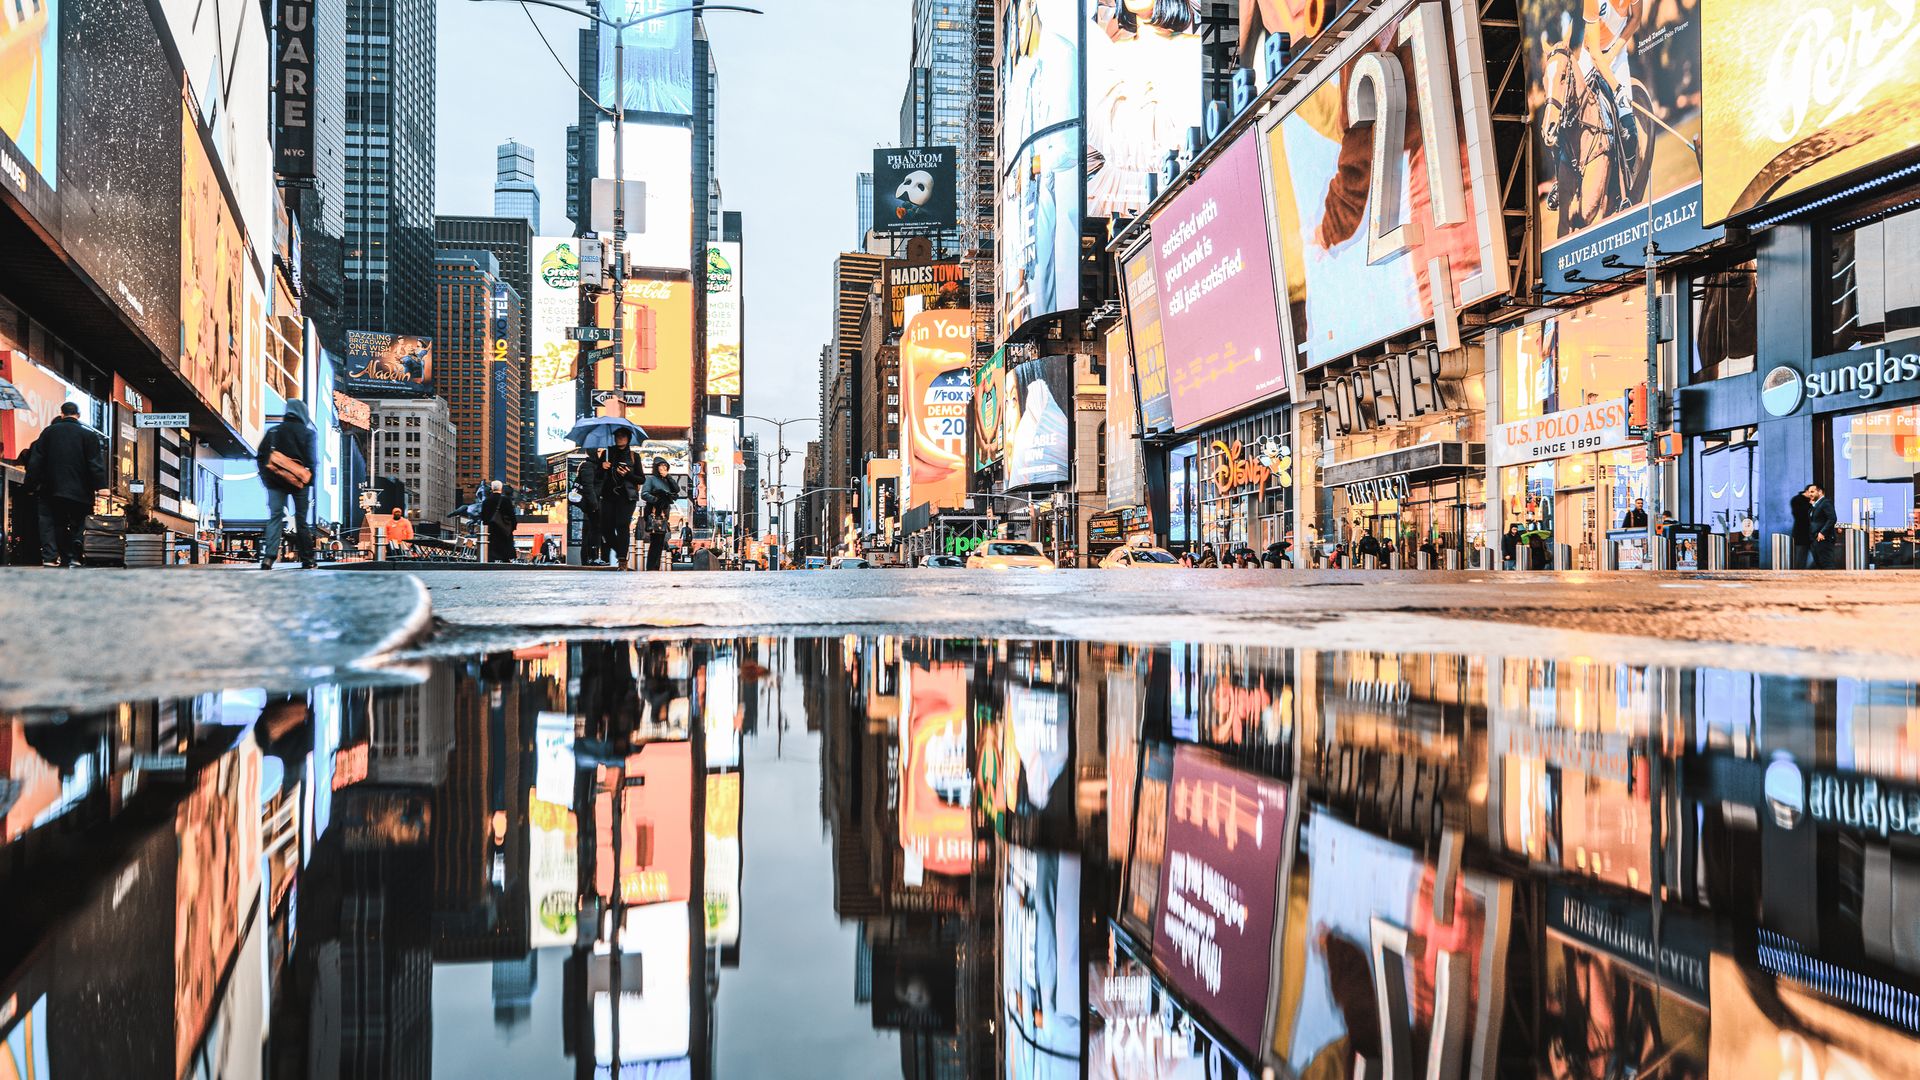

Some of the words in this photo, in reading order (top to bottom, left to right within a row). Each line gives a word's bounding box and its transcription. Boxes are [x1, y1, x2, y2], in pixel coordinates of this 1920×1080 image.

[1638, 36, 1664, 55] Professional
[1664, 31, 1674, 39] Polo
[1674, 21, 1689, 33] Player
[1638, 35, 1652, 48] Jared
[281, 0, 310, 127] UARE
[1347, 1, 1467, 266] 21
[284, 149, 305, 157] NYC
[887, 153, 942, 164] PHANTOM
[1162, 213, 1196, 258] satisfied
[1195, 198, 1217, 232] with
[1165, 263, 1183, 292] your
[1182, 242, 1203, 274] bank
[1201, 235, 1213, 257] is
[891, 264, 963, 286] HADESTOWN
[707, 283, 733, 292] iant
[891, 285, 909, 298] BEST
[909, 283, 941, 296] MUSICAL
[1169, 291, 1184, 316] still
[1183, 278, 1202, 313] just
[543, 306, 578, 315] VEGGIE
[348, 332, 391, 341] DAZZLING
[495, 291, 508, 361] NOVOTEL
[576, 329, 585, 339] W
[588, 330, 600, 340] 45
[917, 322, 929, 341] in
[934, 320, 972, 339] You
[348, 338, 391, 346] BROADWAY
[588, 350, 601, 359] George
[349, 360, 411, 381] Aladdin
[1805, 348, 1920, 399] sunglas
[942, 391, 964, 401] FOX
[1320, 343, 1450, 440] FOREVER
[1506, 424, 1533, 447] U.S.
[1536, 414, 1580, 441] POLO
[1867, 414, 1891, 426] GIFT
[1533, 443, 1566, 456] SINCE
[1572, 436, 1601, 450] 1890
[1211, 440, 1271, 502] Disney
[1344, 478, 1394, 506] FOREVER
[1395, 474, 1412, 500] 21
[878, 483, 886, 531] COVERGIRL
